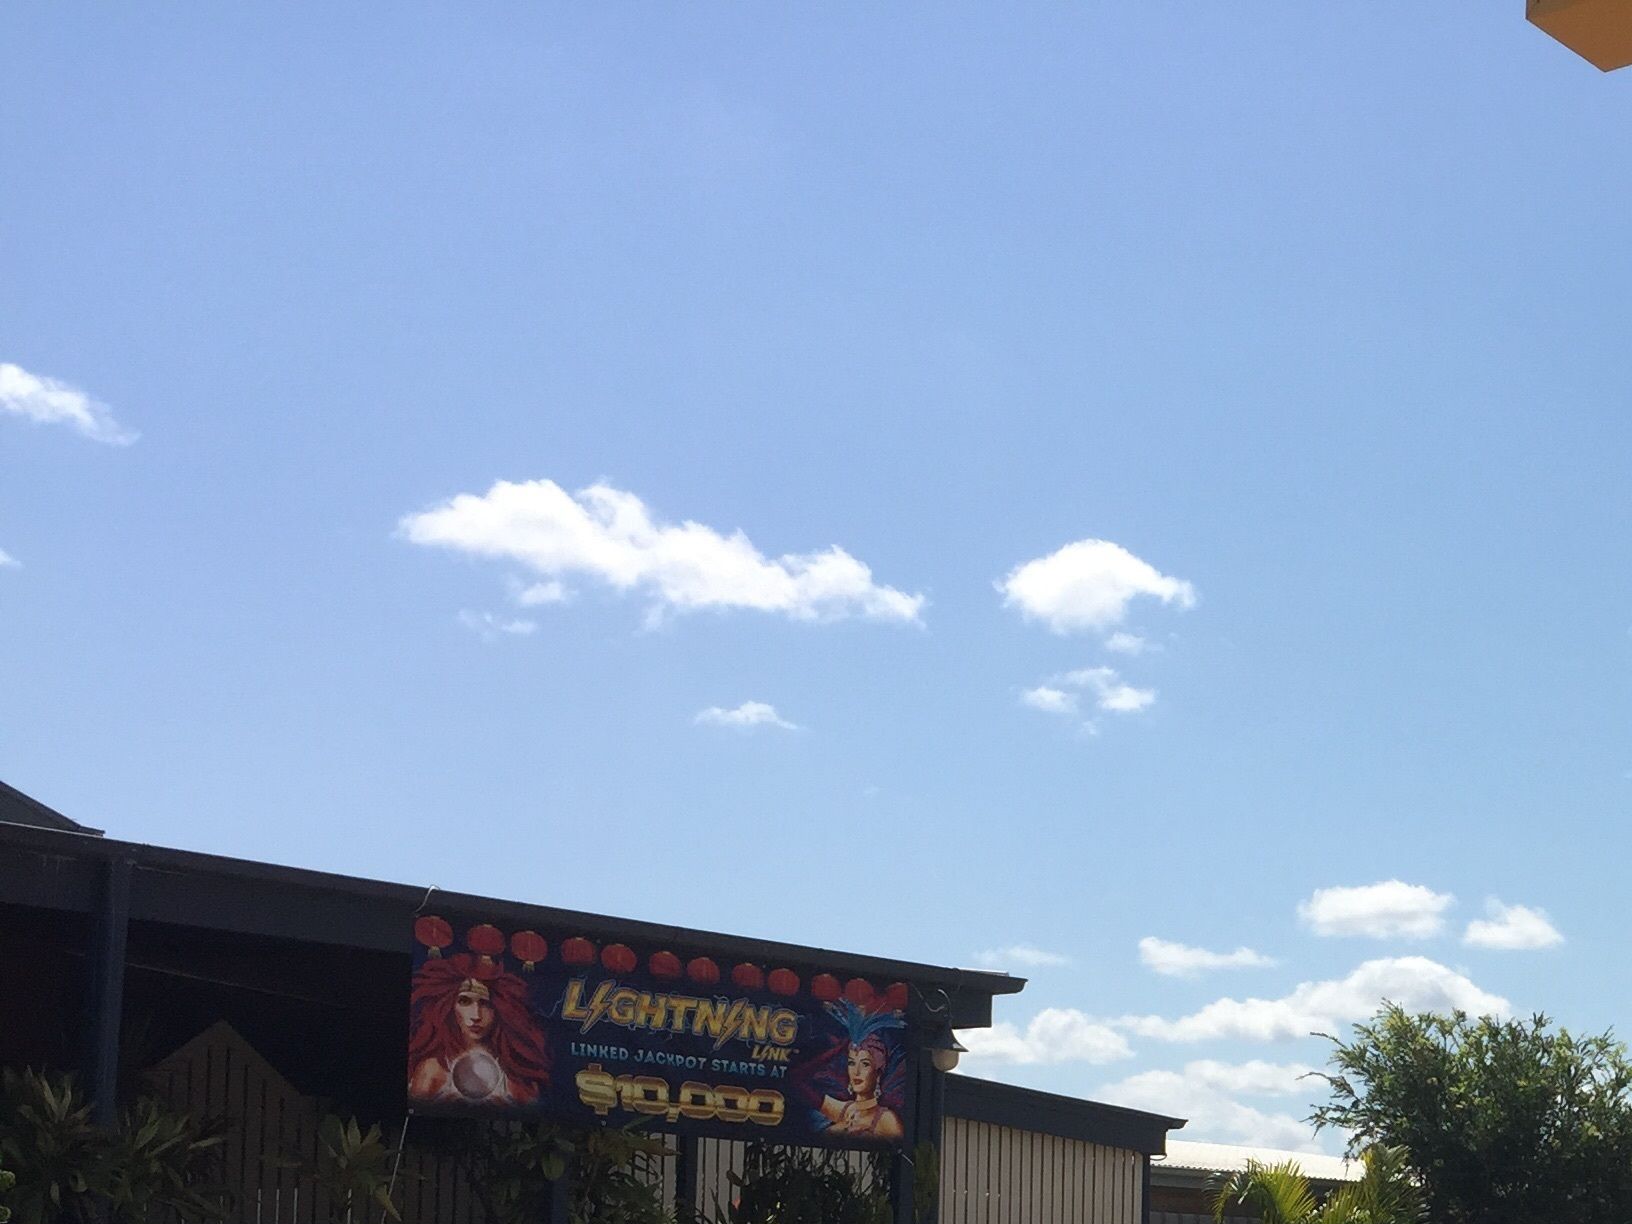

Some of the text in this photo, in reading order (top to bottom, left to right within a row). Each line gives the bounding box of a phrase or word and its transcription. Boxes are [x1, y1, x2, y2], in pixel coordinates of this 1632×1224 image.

[562, 977, 798, 1050] LIGHTNING
[571, 1042, 788, 1078] LINKED JACKPOT STARTS AT
[575, 1063, 785, 1126] $10,000
